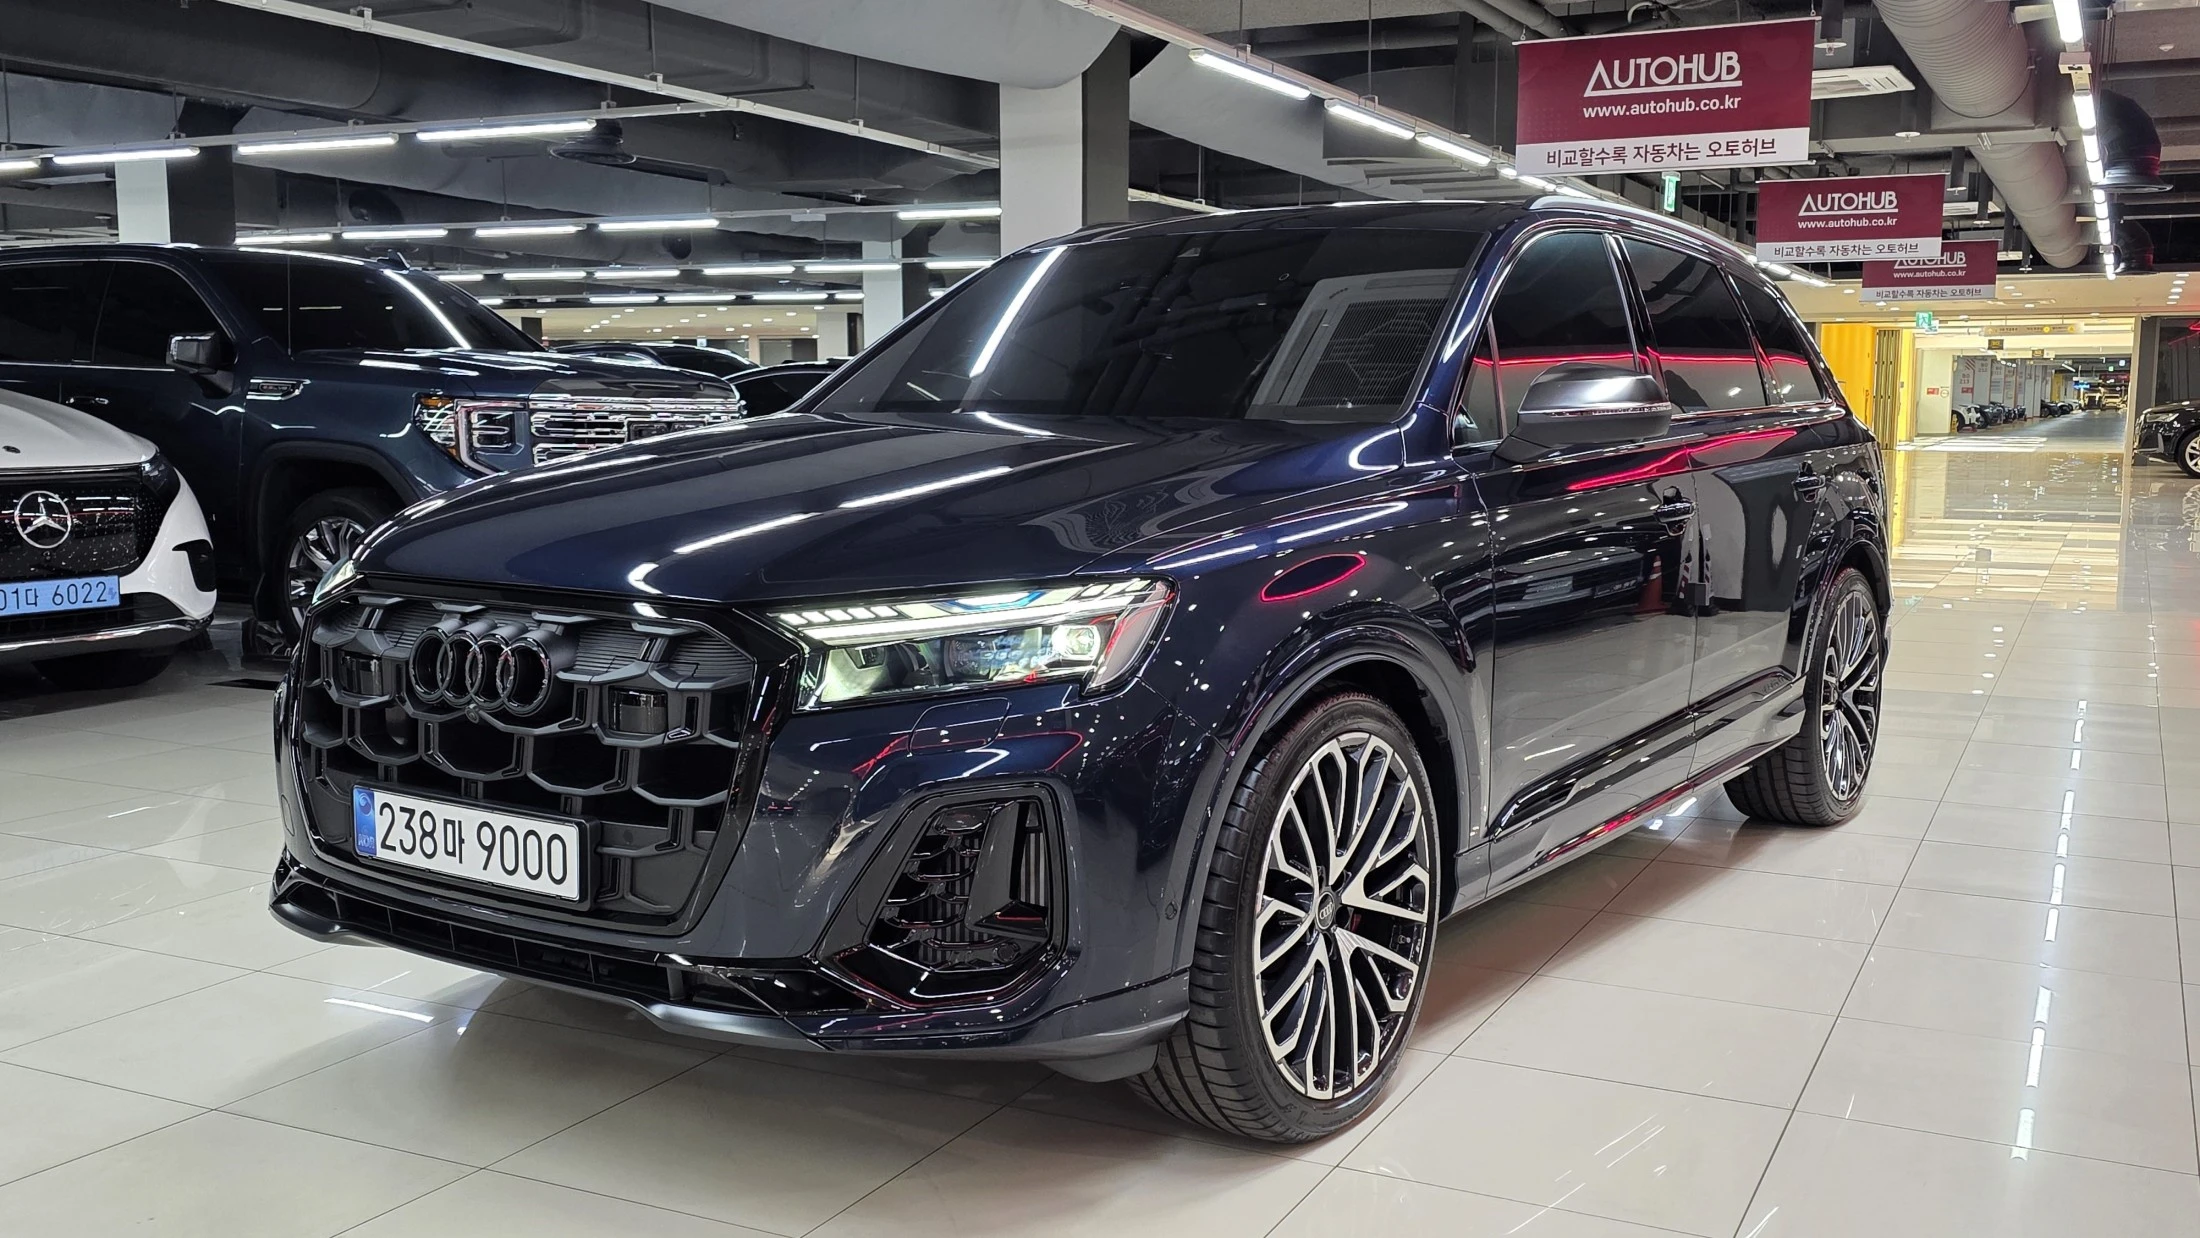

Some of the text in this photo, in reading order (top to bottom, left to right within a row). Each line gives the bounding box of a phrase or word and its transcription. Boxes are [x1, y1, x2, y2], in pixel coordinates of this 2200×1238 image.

[1584, 51, 1743, 97] AUTOHUB
[1583, 94, 1742, 118] www.autohub.co.kr
[1547, 138, 1777, 168] 비교할수록 자동차는 오토허브
[1798, 190, 1899, 216] AUTOHUB
[1797, 216, 1898, 229] www.autohub.co.kr
[1774, 242, 1919, 257] 비교할수록 자동차는 오토허브
[1893, 269, 1967, 278] www.autohub.co.kr
[1876, 287, 1982, 299] 비교할수록 자동차는 오토허브
[52, 581, 107, 606] 6022
[379, 802, 567, 885] 238마 9000
